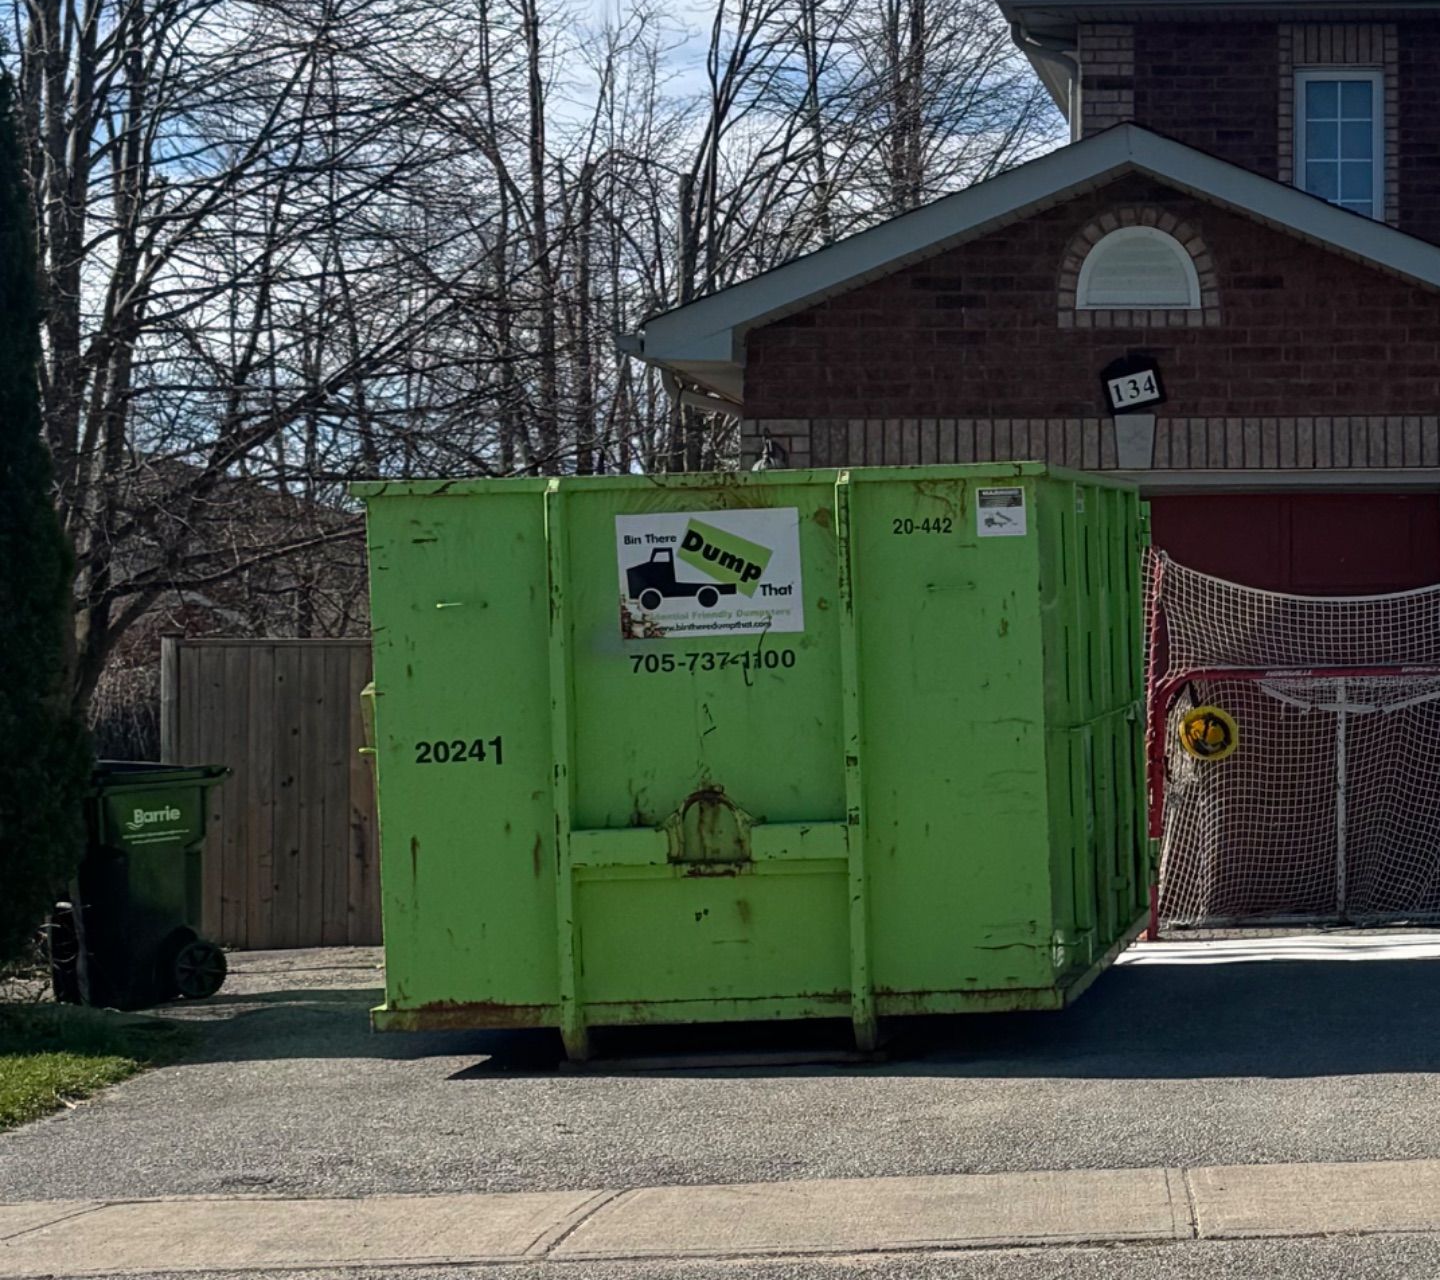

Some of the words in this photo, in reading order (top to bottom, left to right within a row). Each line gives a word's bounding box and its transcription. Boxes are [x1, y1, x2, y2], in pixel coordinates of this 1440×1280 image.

[1113, 375, 1156, 403] 134
[892, 517, 953, 535] 20-442
[623, 534, 642, 545] Bin
[645, 533, 677, 544] There
[680, 528, 762, 583] Dump
[760, 583, 793, 597] That
[629, 649, 796, 674] 705-737-1100
[415, 735, 502, 765] 20241
[133, 805, 181, 824] Barrie
